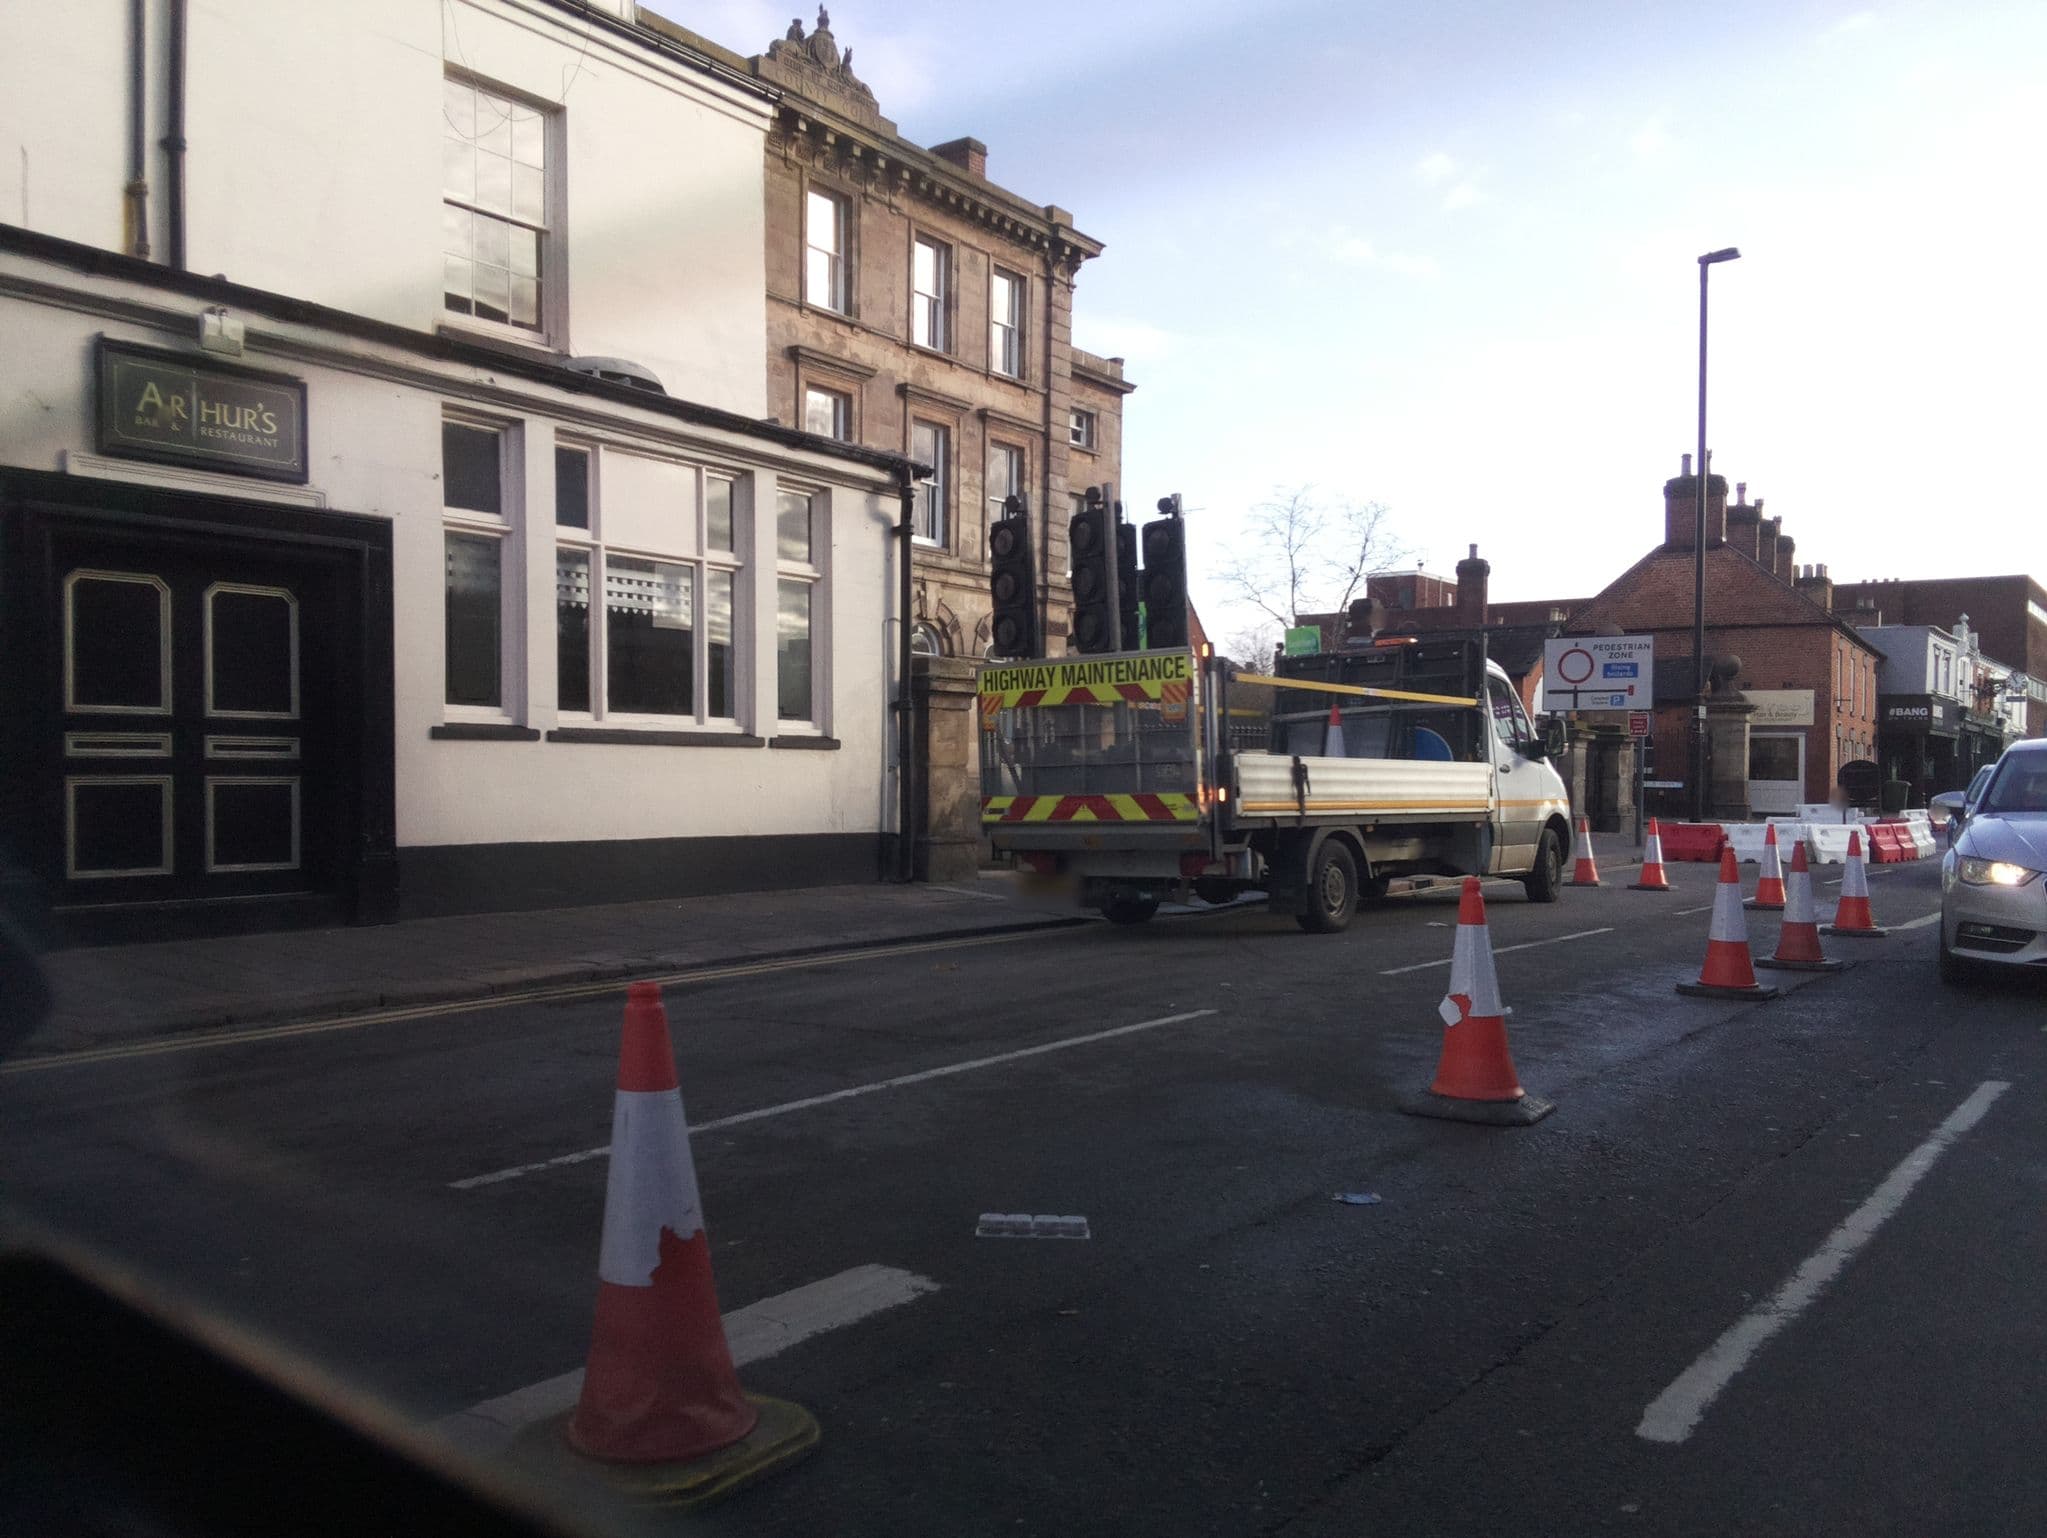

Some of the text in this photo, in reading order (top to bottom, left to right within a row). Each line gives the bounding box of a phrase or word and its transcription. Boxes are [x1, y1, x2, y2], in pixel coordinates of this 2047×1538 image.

[200, 427, 280, 449] RESTAURANT
[1593, 643, 1650, 652] PEDESTRIAN
[1608, 651, 1633, 659] ZONE
[983, 656, 1185, 692] HIGHWAY MAINTENANCE
[1889, 707, 1929, 716] #BANG
